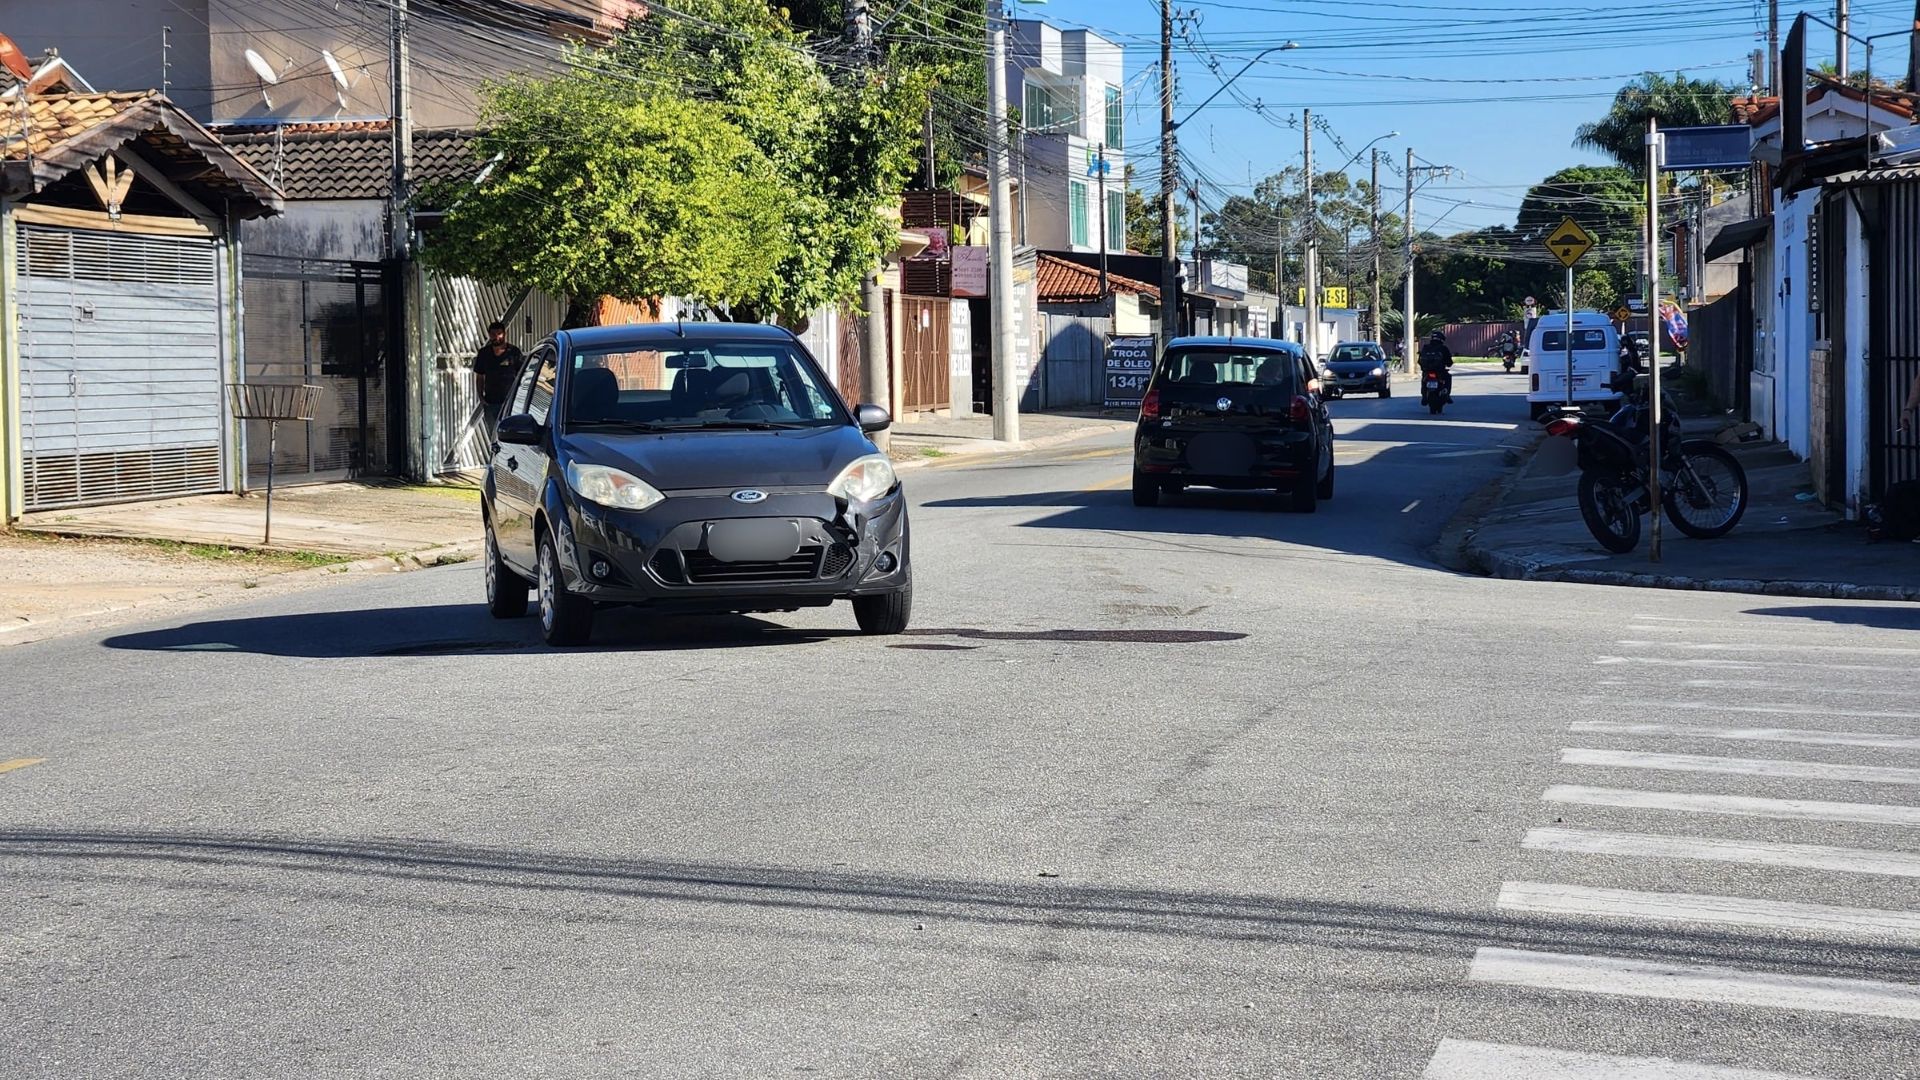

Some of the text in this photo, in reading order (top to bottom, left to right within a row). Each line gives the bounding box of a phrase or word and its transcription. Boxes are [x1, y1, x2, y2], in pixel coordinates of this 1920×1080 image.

[1810, 217, 1818, 300] HAMBURGUERIA
[1112, 349, 1147, 357] TROCA
[1123, 358, 1151, 368] ÓLEO
